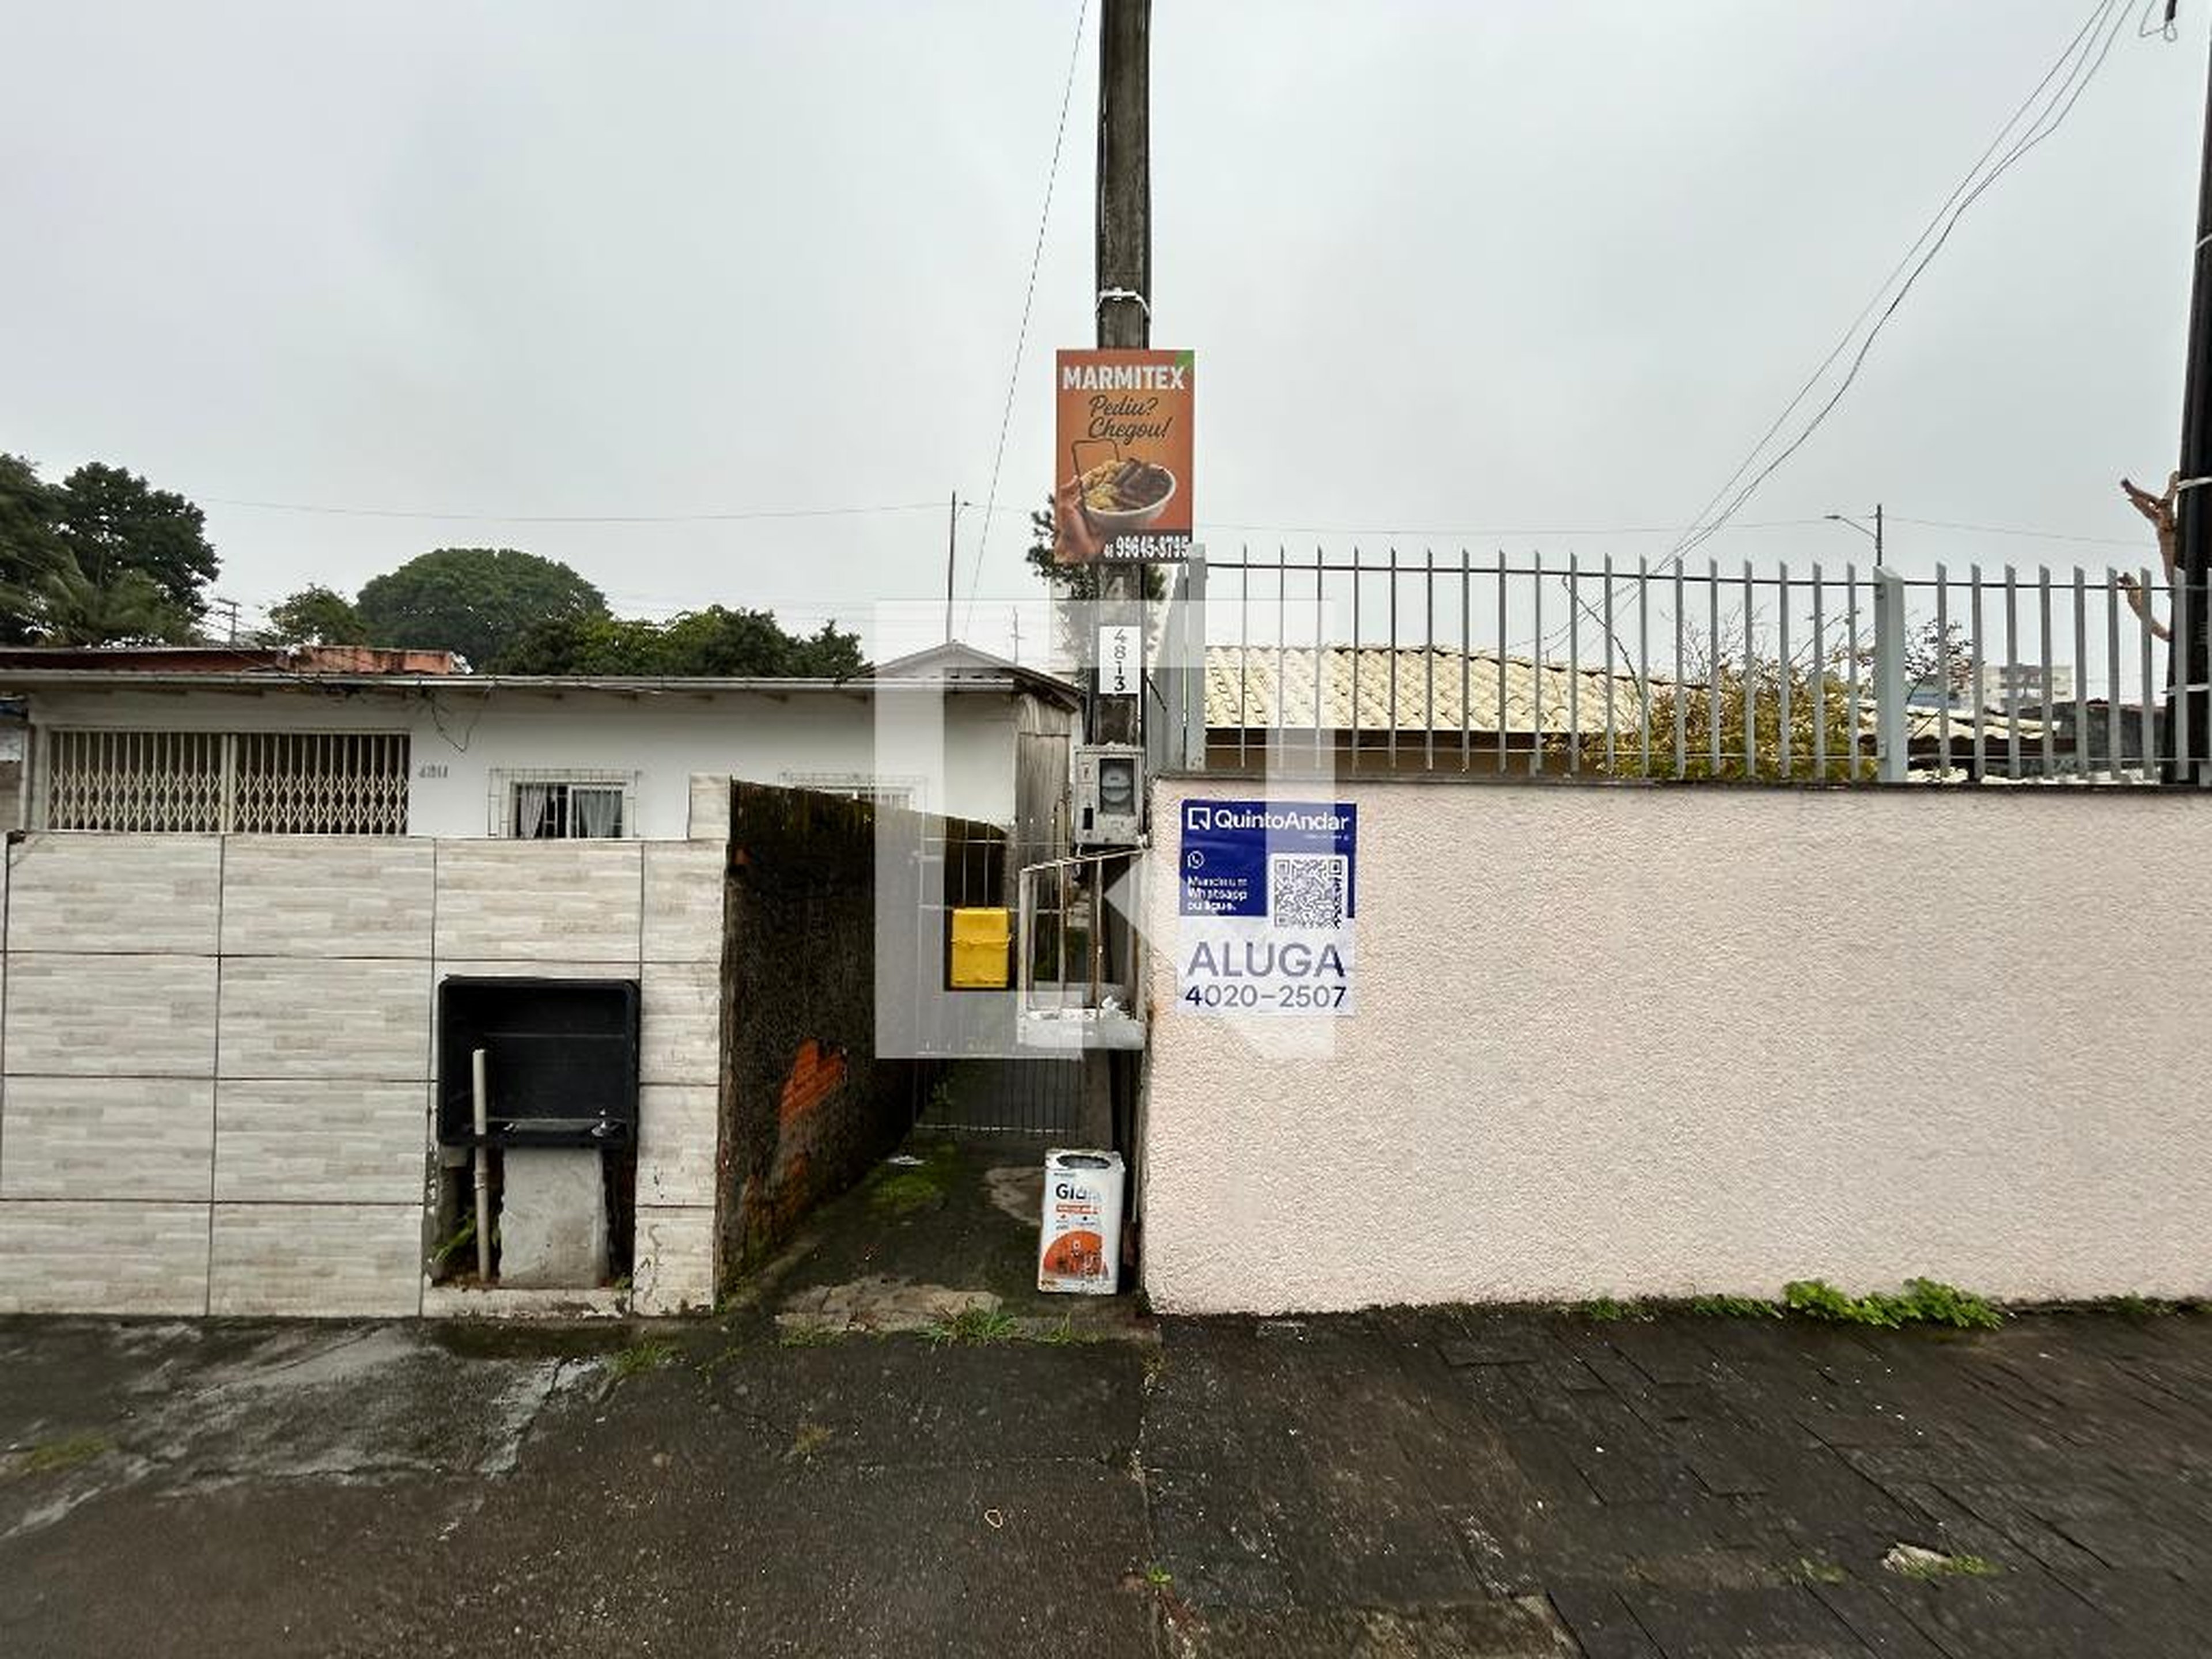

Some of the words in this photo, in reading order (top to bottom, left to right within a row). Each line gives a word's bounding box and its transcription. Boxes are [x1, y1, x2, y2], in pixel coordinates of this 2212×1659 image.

[1063, 365, 1184, 390] MARMITEX
[1089, 395, 1158, 417] Pediu?
[1088, 416, 1172, 445] Chegou!
[1114, 628, 1126, 691] 4813
[1215, 809, 1350, 830] QuintoAndar
[1187, 941, 1344, 978] ALUGA
[1185, 985, 1347, 1007] 4020-2507
